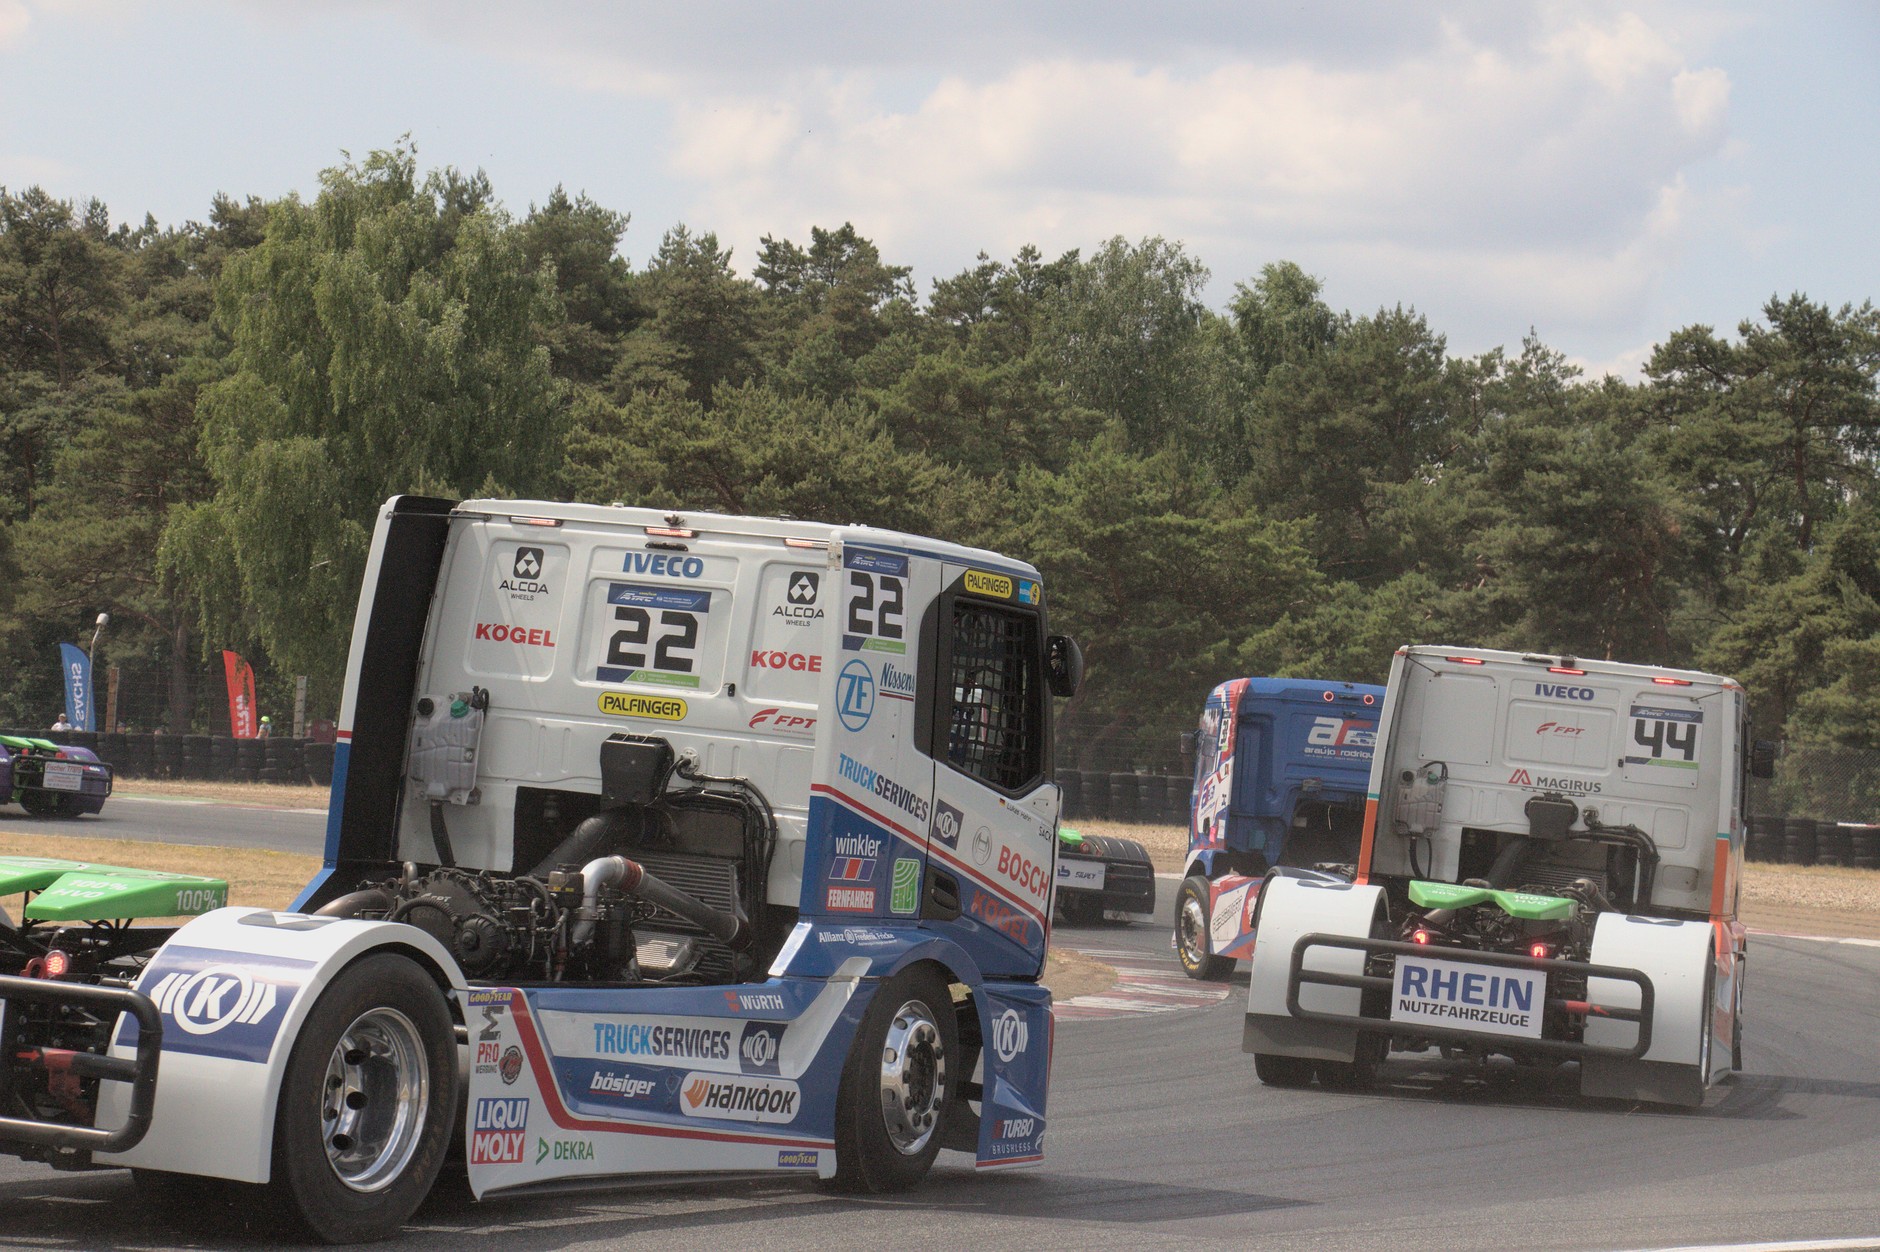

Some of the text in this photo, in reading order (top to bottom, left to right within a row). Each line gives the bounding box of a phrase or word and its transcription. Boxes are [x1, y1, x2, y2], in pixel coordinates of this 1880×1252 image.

[622, 552, 703, 578] IVECO
[499, 579, 548, 595] ALCOA
[968, 573, 1010, 595] PALFINGER
[510, 593, 534, 601] WHEELS
[848, 570, 903, 639] 22
[772, 606, 824, 619] ALCOA
[785, 619, 811, 627] WHEELS
[475, 622, 555, 647] KÖGEL
[607, 606, 698, 672] 22
[879, 662, 915, 693] Nissens
[840, 673, 873, 719] ZF
[1534, 683, 1595, 701] IVECO
[603, 696, 681, 717] PALFINGER
[773, 715, 817, 728] FPT
[1553, 726, 1585, 735] FPT
[1634, 719, 1697, 760] 44
[1536, 776, 1602, 793] MAGIRUS
[836, 833, 881, 857] winkler
[997, 844, 1050, 900] BOSCH
[51, 888, 104, 898] HVO
[68, 879, 128, 891] 100%
[176, 889, 218, 911] 100%
[827, 888, 874, 909] FERNFAHRER
[970, 889, 1030, 945] KÖGEL
[819, 931, 846, 943] Allianz
[1400, 965, 1533, 1012] RHEIN
[739, 993, 784, 1011] WÜRTH
[1399, 999, 1530, 1028] NUTZFAHRZEUGE
[476, 1042, 499, 1064] PRO
[590, 1071, 656, 1098] bösiger
[477, 1099, 527, 1130] LIQUI
[1002, 1118, 1034, 1138] TURBO
[472, 1133, 524, 1164] MOLY
[554, 1137, 594, 1160] DEKRA
[779, 1151, 817, 1165] GOODYEAR
[992, 1142, 1031, 1155] BRUSHLESS
